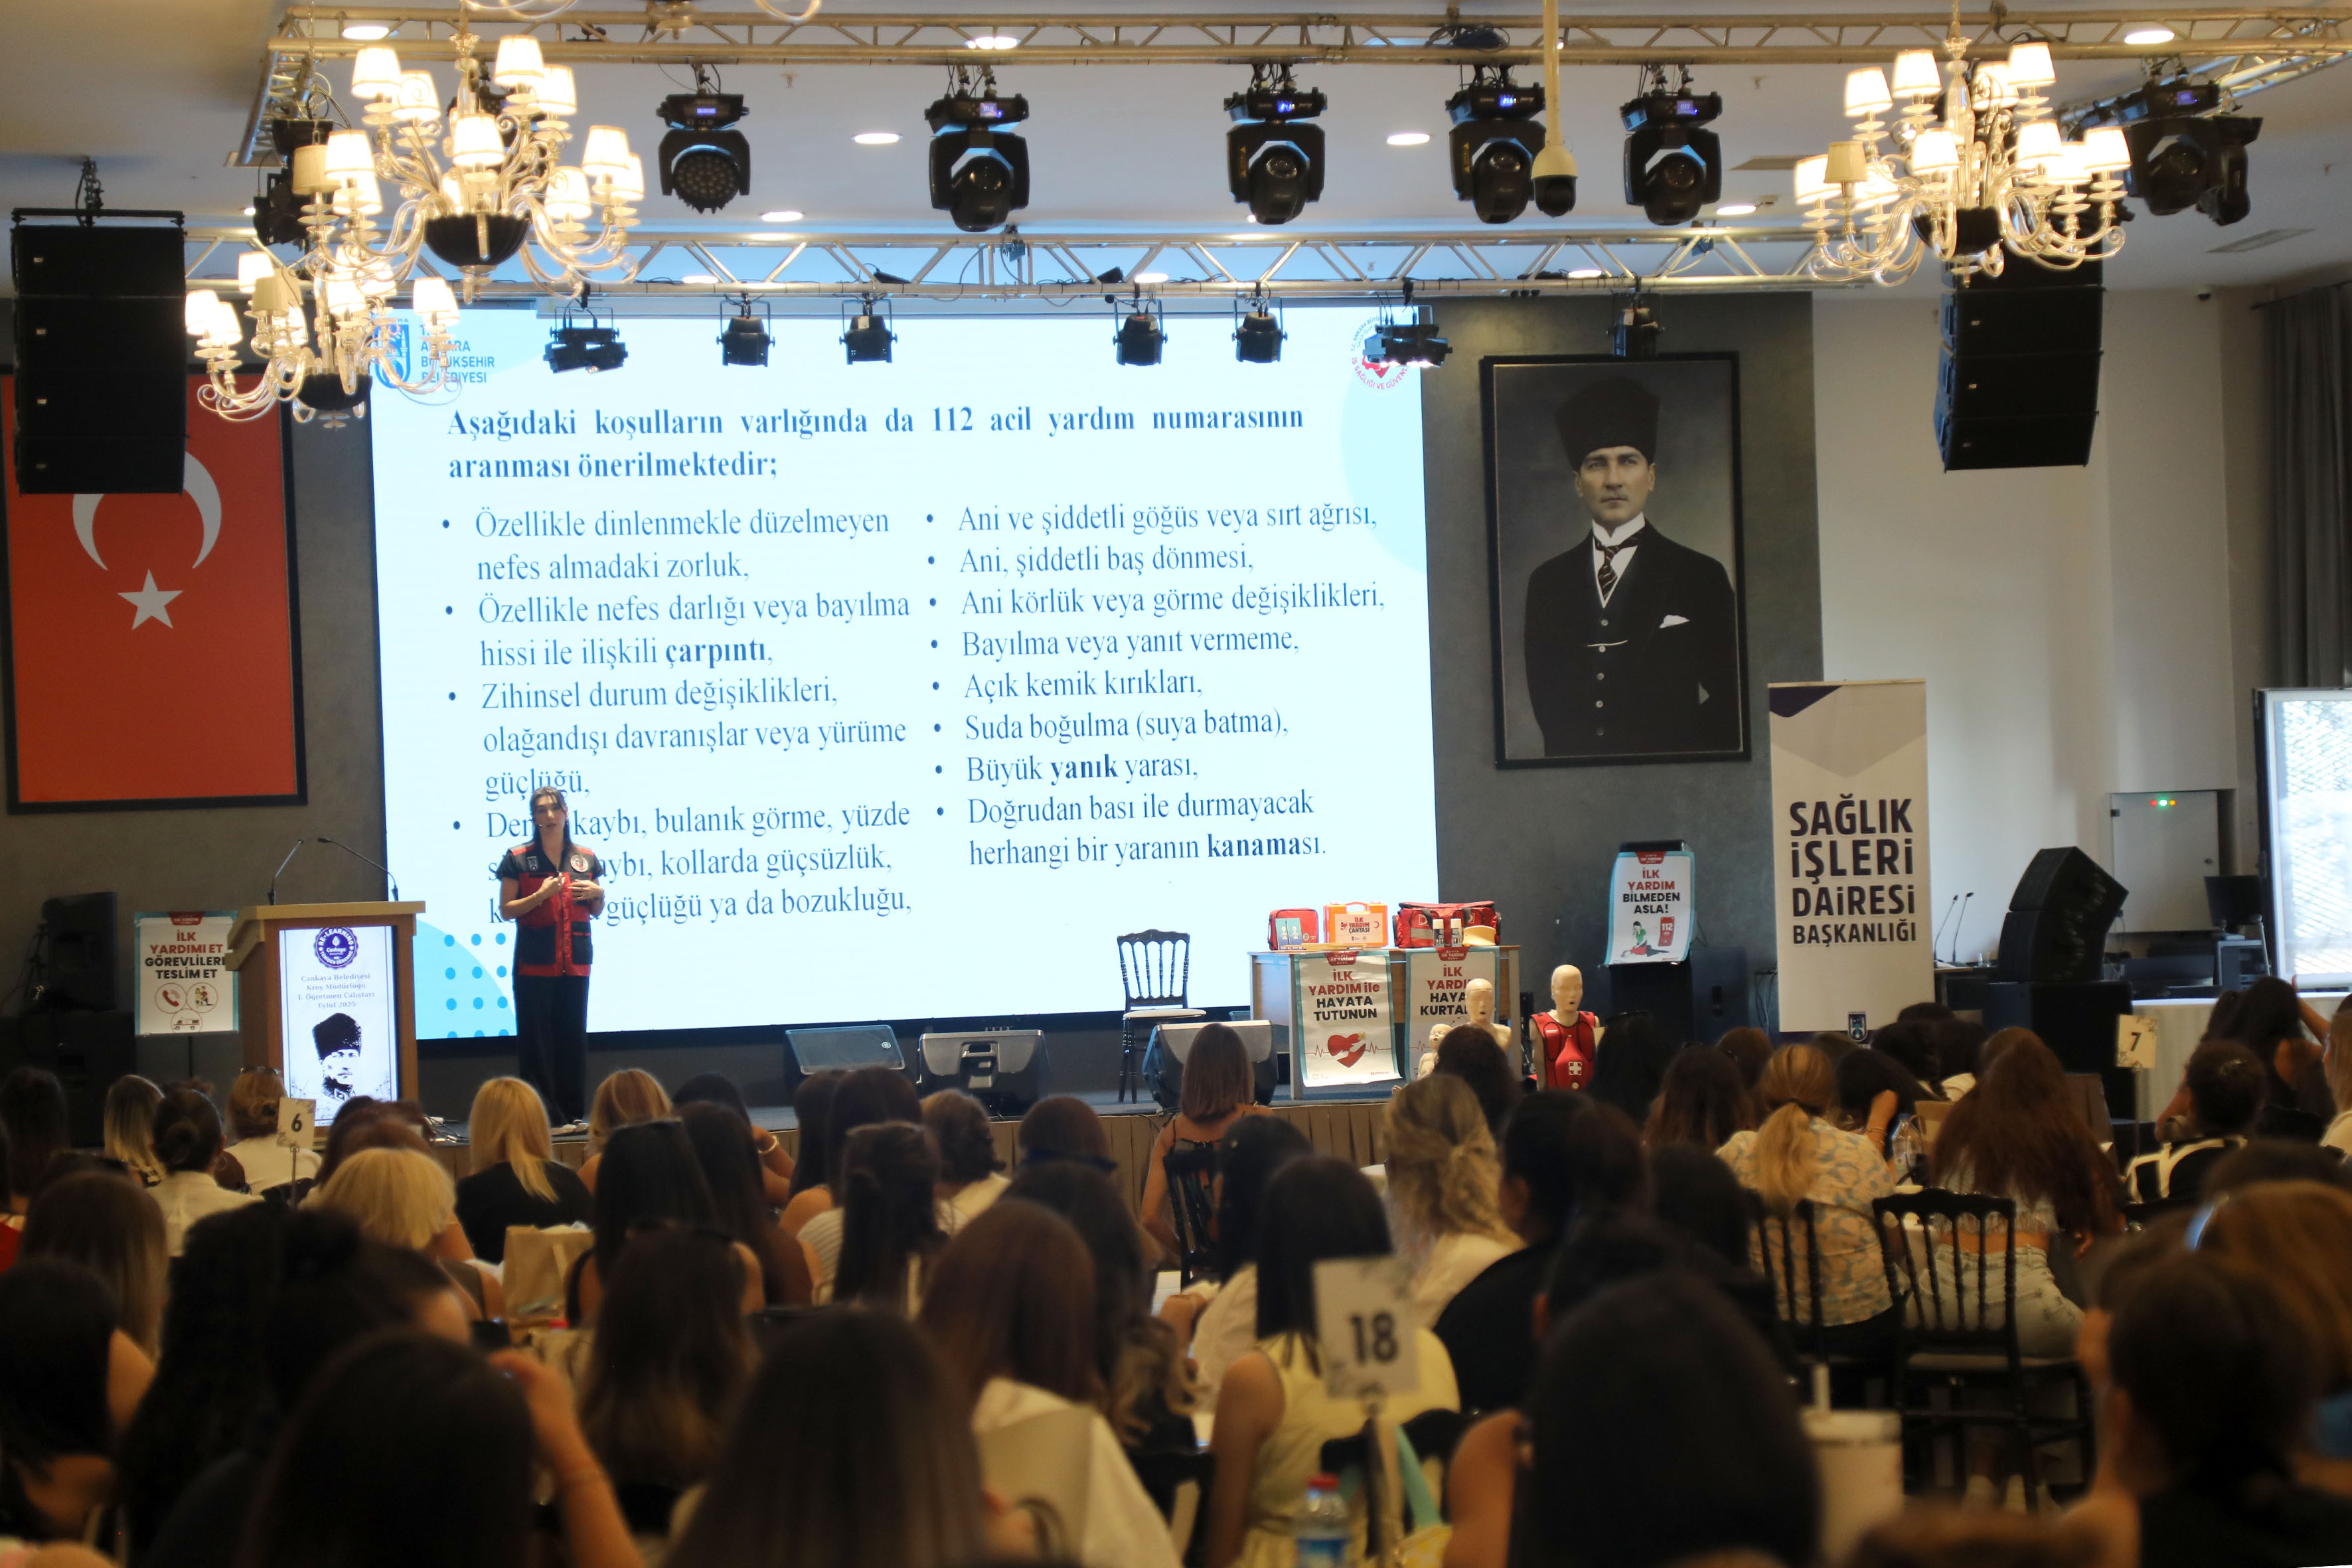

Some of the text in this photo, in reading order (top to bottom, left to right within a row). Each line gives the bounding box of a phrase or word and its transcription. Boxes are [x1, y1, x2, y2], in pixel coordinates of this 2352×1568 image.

[1386, 368, 1408, 389] GÜVENL
[447, 405, 1303, 442] Aşağıdaki koşulların varlığında da 112 acil yardım numarasının
[449, 450, 777, 479] aranması önerilmektedir;
[475, 506, 889, 540] Özellikle dinlenmekle düzelmeyen
[959, 503, 1377, 536] Ani ve şiddetli göğüs veya sırt ağrısı,
[477, 551, 749, 582] nefes almadaki zorluk,
[959, 542, 1253, 578] Ani, şiddetli baş dönmesi,
[479, 591, 910, 627] Özellikle nefes darlığı veya bayılma
[961, 581, 1385, 619] Ani körlük veya görme değişiklikleri,
[480, 637, 773, 670] hissi ile ilişkili çarpıntı,
[963, 629, 1299, 663] Bayılma veya yanıt vermeme,
[481, 675, 837, 712] Zihinsel durum değişiklikleri,
[964, 668, 1202, 704] Açık kemik kırıkları,
[483, 720, 906, 759] olağandışı davranışlar veya yürüme
[966, 708, 1289, 745] Suda boğulma (suya batma),
[967, 753, 1198, 788] Büyük yanık yarası,
[573, 808, 647, 842] kaybı,
[655, 807, 744, 834] bulanık
[752, 807, 832, 837] görme,
[841, 800, 910, 833] yüzde
[968, 788, 1314, 830] Doğrudan bası ile durmayacak
[1790, 793, 1913, 836] SAĞLIK
[601, 842, 892, 884] aybı, kollarda güçsüzlük,
[969, 833, 1326, 870] herhangi bir yaranın kanaması.
[1628, 881, 1675, 890] YARDIM
[1642, 867, 1660, 878] İLK
[606, 886, 911, 927] güçlüğü ya da bozukluğu,
[1623, 890, 1680, 902] BİLMEDEN
[1634, 903, 1668, 914] ASLA!
[177, 929, 196, 941] İLK
[1793, 919, 1917, 947] BAŞKANLIĞI
[149, 944, 223, 954] YARDIMI ET
[155, 967, 218, 979] TESLİM ET
[1333, 969, 1354, 981] İLK
[1427, 979, 1471, 990] YARDI
[1443, 964, 1462, 977] İLK
[1308, 981, 1380, 996] YARDIM ile
[1316, 996, 1373, 1008] HAYATA
[1430, 992, 1466, 1002] HAYA
[1314, 1008, 1377, 1021] TUTUNUN
[1420, 1004, 1468, 1016] KURTA
[2130, 1032, 2142, 1052] 7
[291, 1113, 302, 1133] 6
[1349, 1312, 1398, 1364] 18
